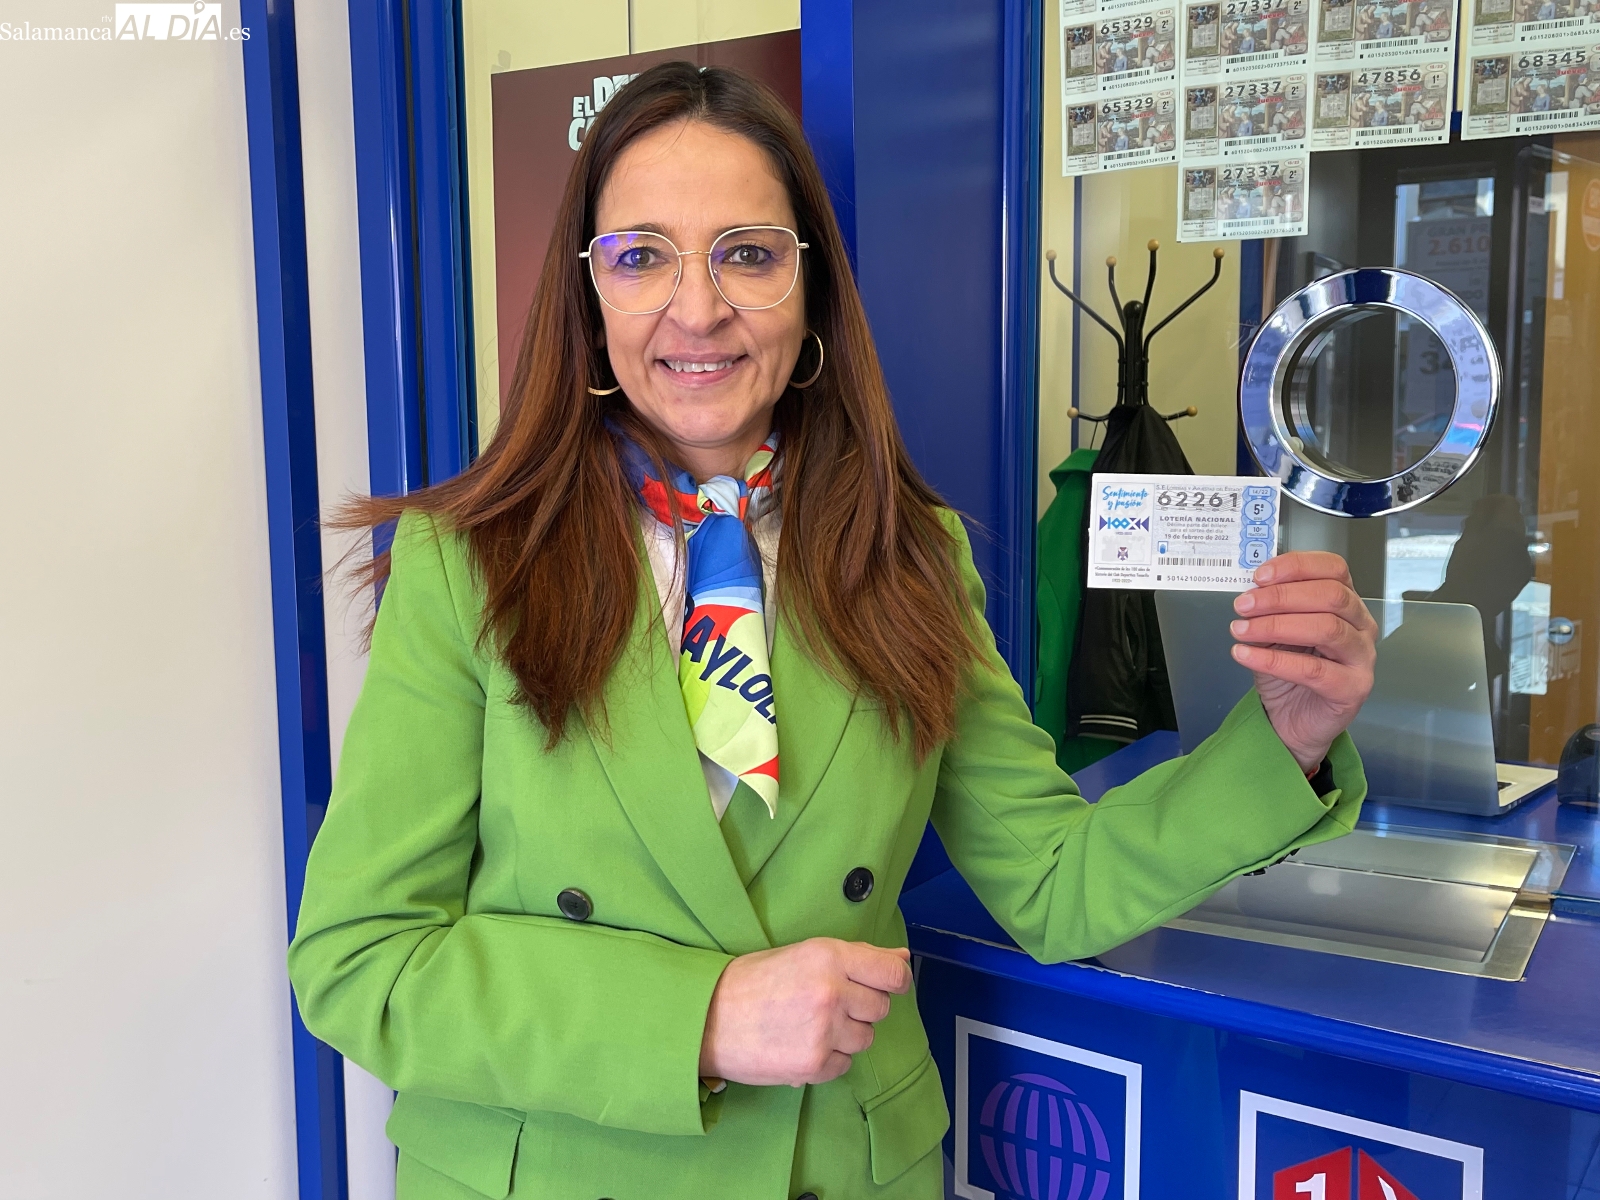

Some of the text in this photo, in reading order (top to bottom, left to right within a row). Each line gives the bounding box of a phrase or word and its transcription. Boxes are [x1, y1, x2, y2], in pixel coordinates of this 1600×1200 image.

[1100, 16, 1153, 34] 65329
[1518, 51, 1586, 68] 68345
[1358, 69, 1421, 84] 47856
[1224, 81, 1282, 98] 27337
[573, 96, 594, 118] EL
[1102, 97, 1154, 114] 65329
[1224, 164, 1280, 180] 27337
[1102, 486, 1149, 500] Sentimiento
[1158, 491, 1238, 508] 62261
[1114, 499, 1142, 510] pasión
[1253, 549, 1259, 558] 6
